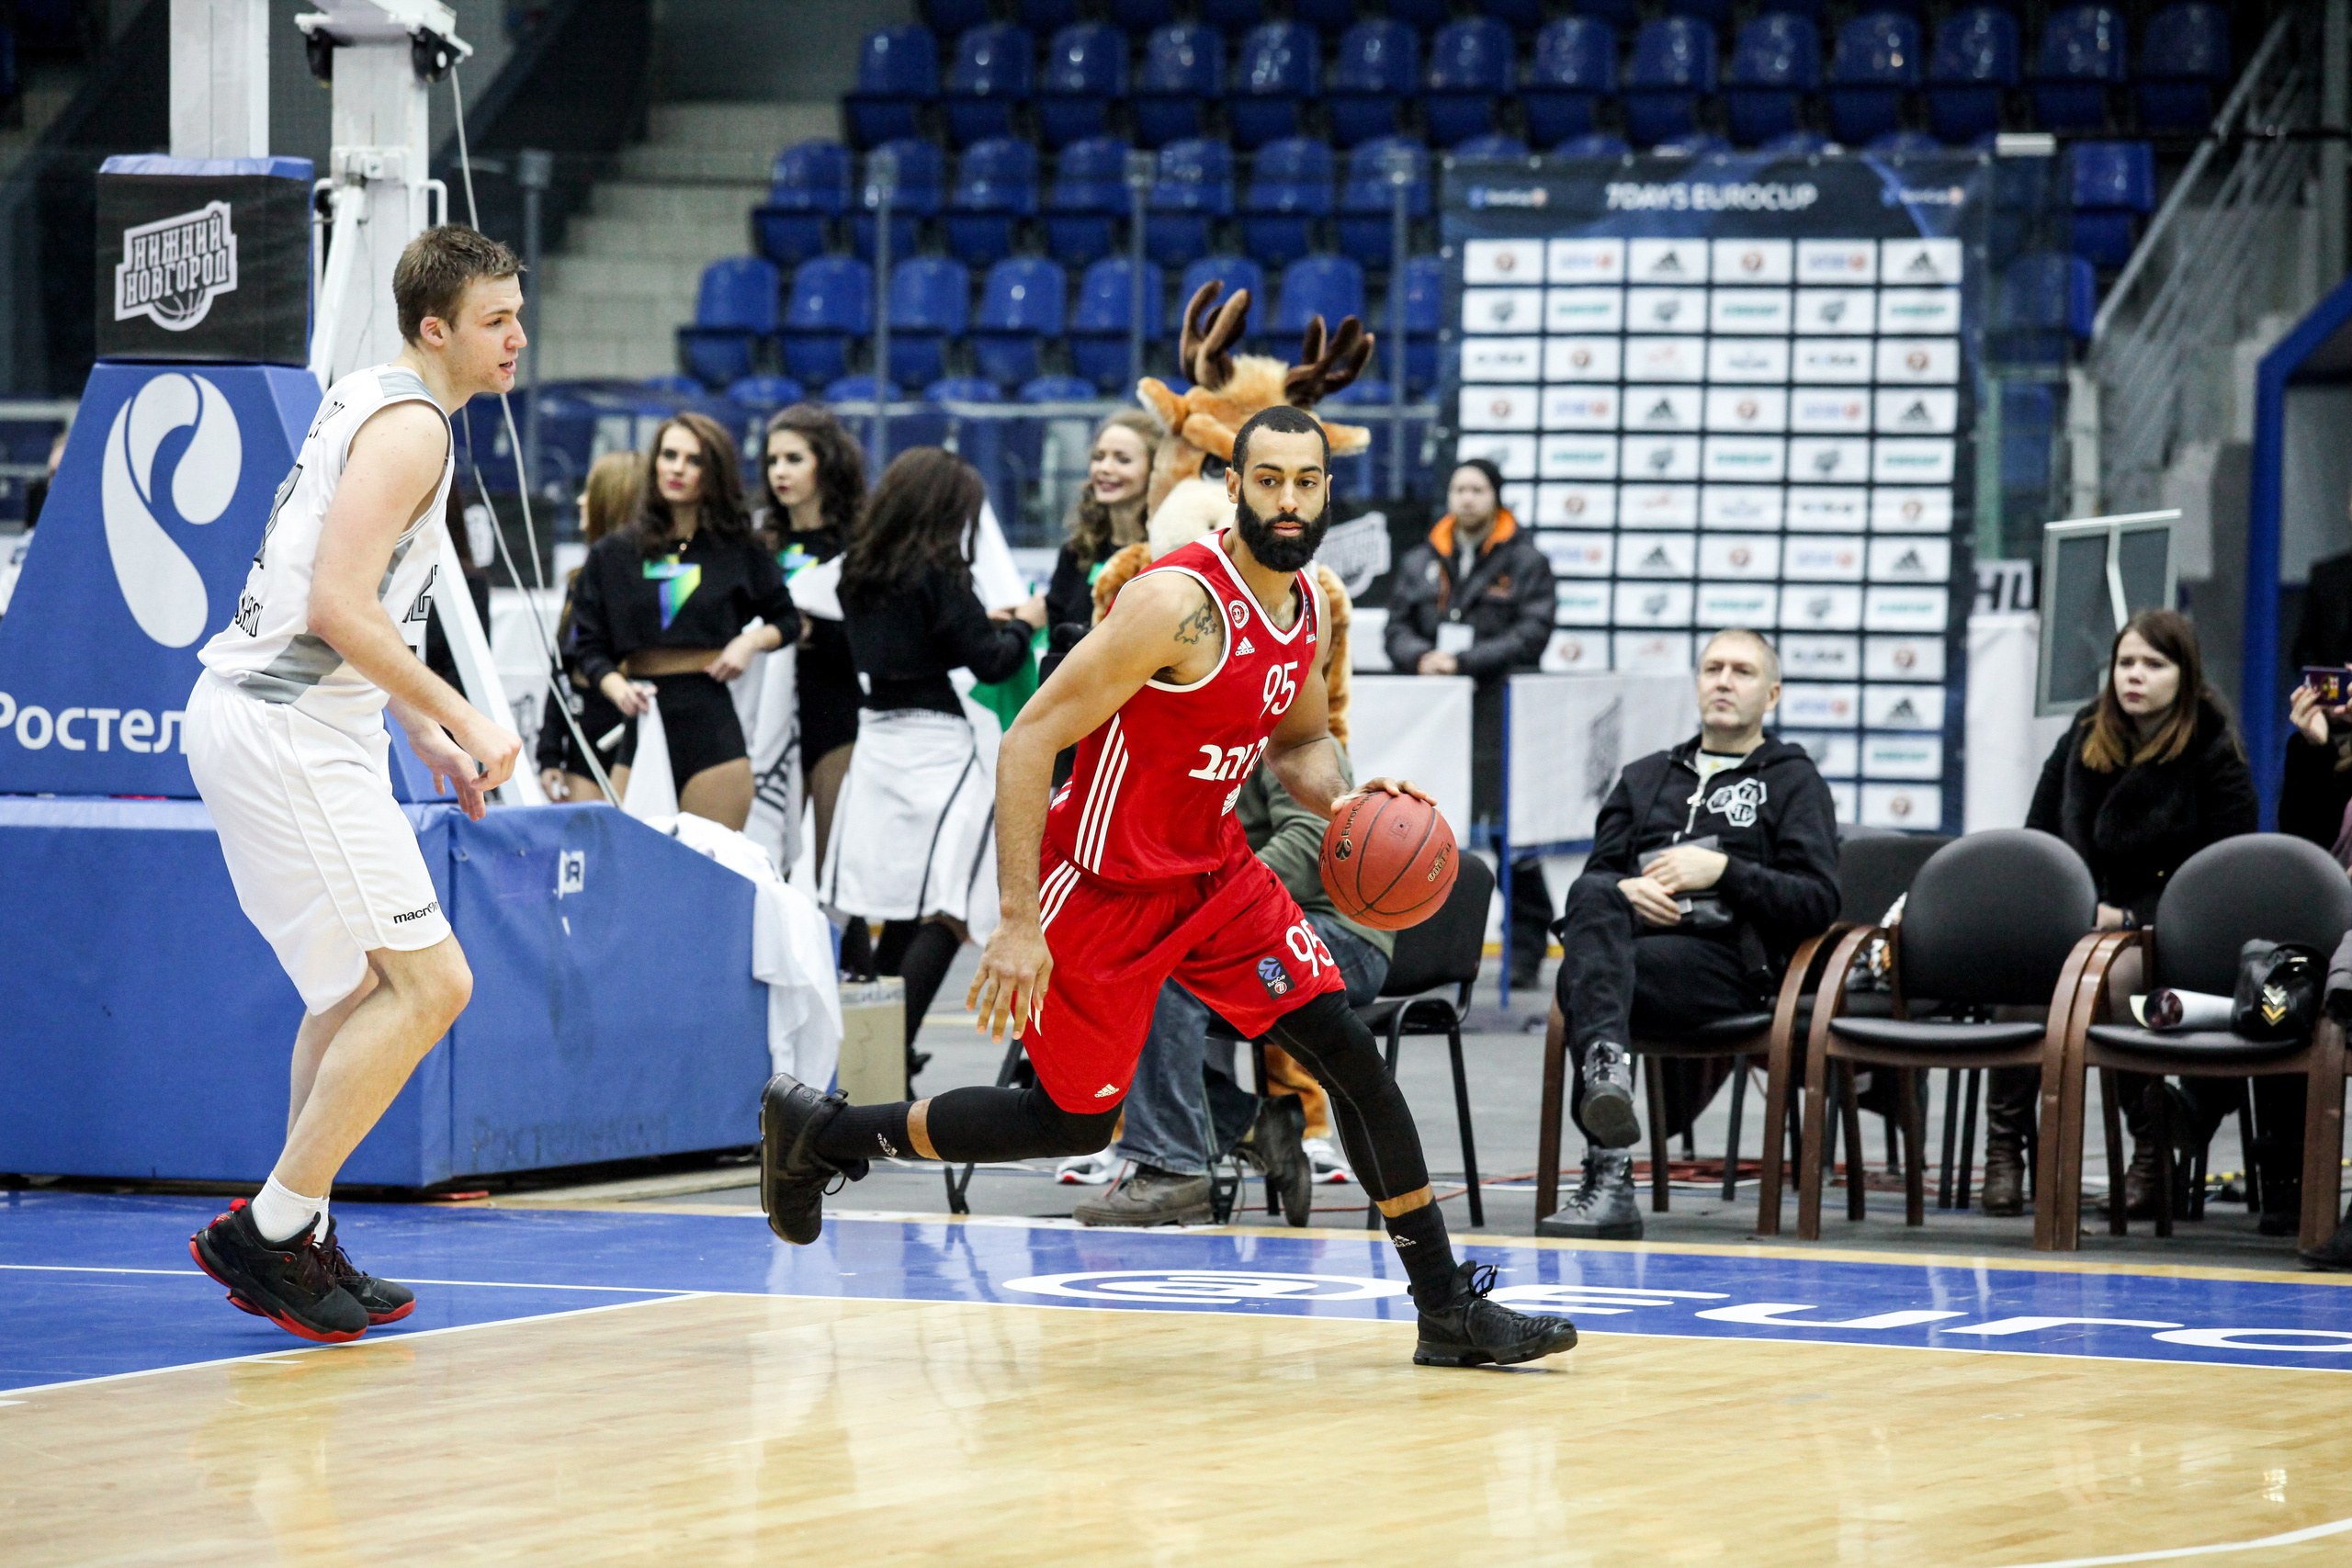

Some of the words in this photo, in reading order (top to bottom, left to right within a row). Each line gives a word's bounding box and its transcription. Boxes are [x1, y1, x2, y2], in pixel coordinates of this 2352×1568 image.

[1605, 182, 1688, 210] 7DAYS
[1691, 183, 1817, 210] EUROCUP
[132, 210, 221, 272] НИЖНИЙ
[125, 248, 229, 308] НОВГОРОД
[1235, 646, 1256, 657] adidas
[1259, 660, 1298, 718] 95
[1286, 919, 1335, 977] 95
[1267, 974, 1286, 987] EuroCup
